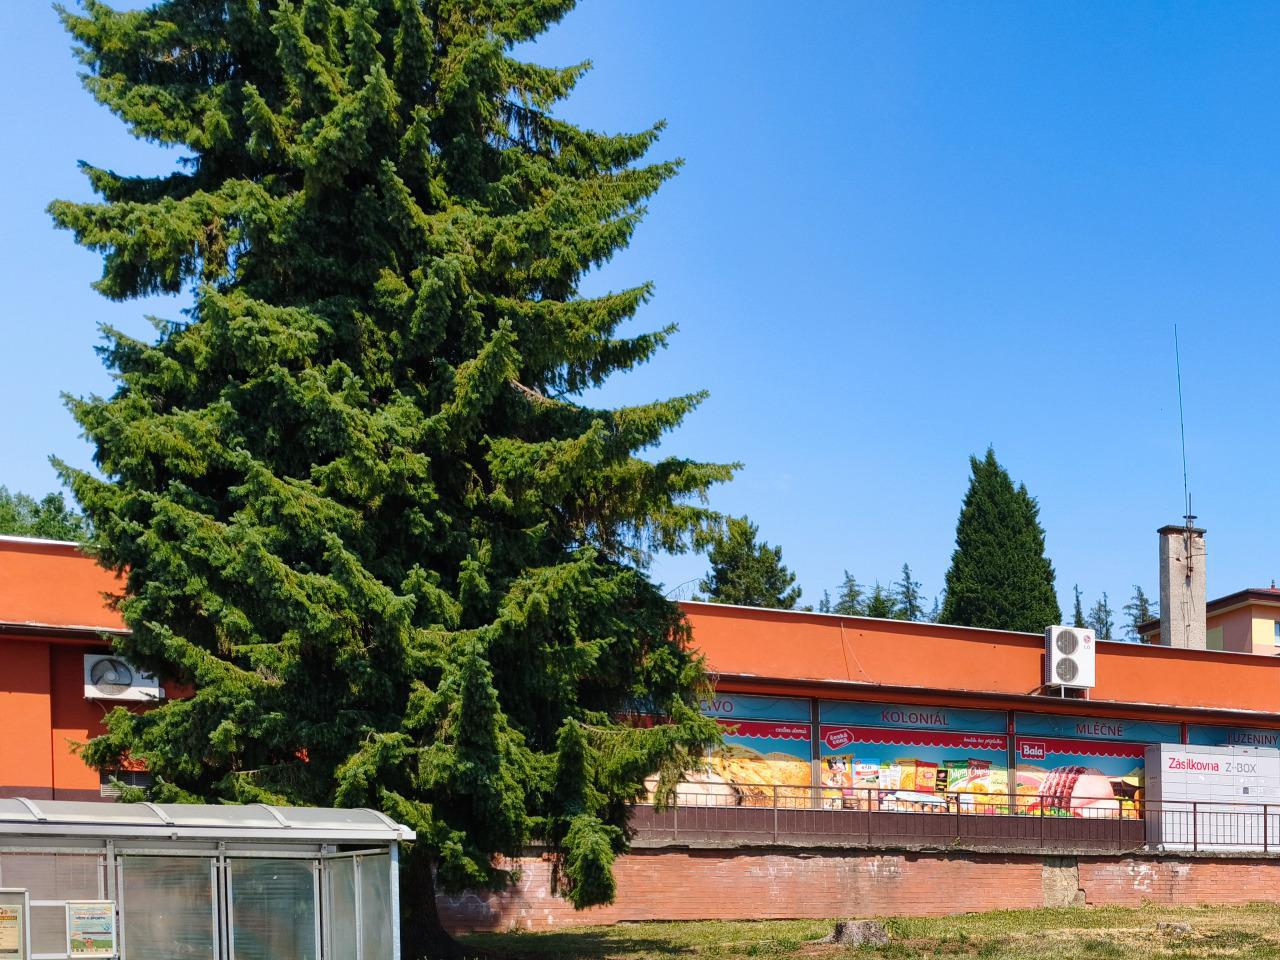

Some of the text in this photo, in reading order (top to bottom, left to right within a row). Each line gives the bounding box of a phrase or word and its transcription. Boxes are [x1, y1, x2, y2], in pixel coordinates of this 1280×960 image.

[881, 709, 949, 726] KOLONIÁL
[1076, 721, 1124, 736] MLÉČNÉ
[1234, 733, 1279, 745] UZENINY
[1023, 745, 1043, 756] Bala
[1168, 757, 1257, 773] Zásilkovna Z-BOX
